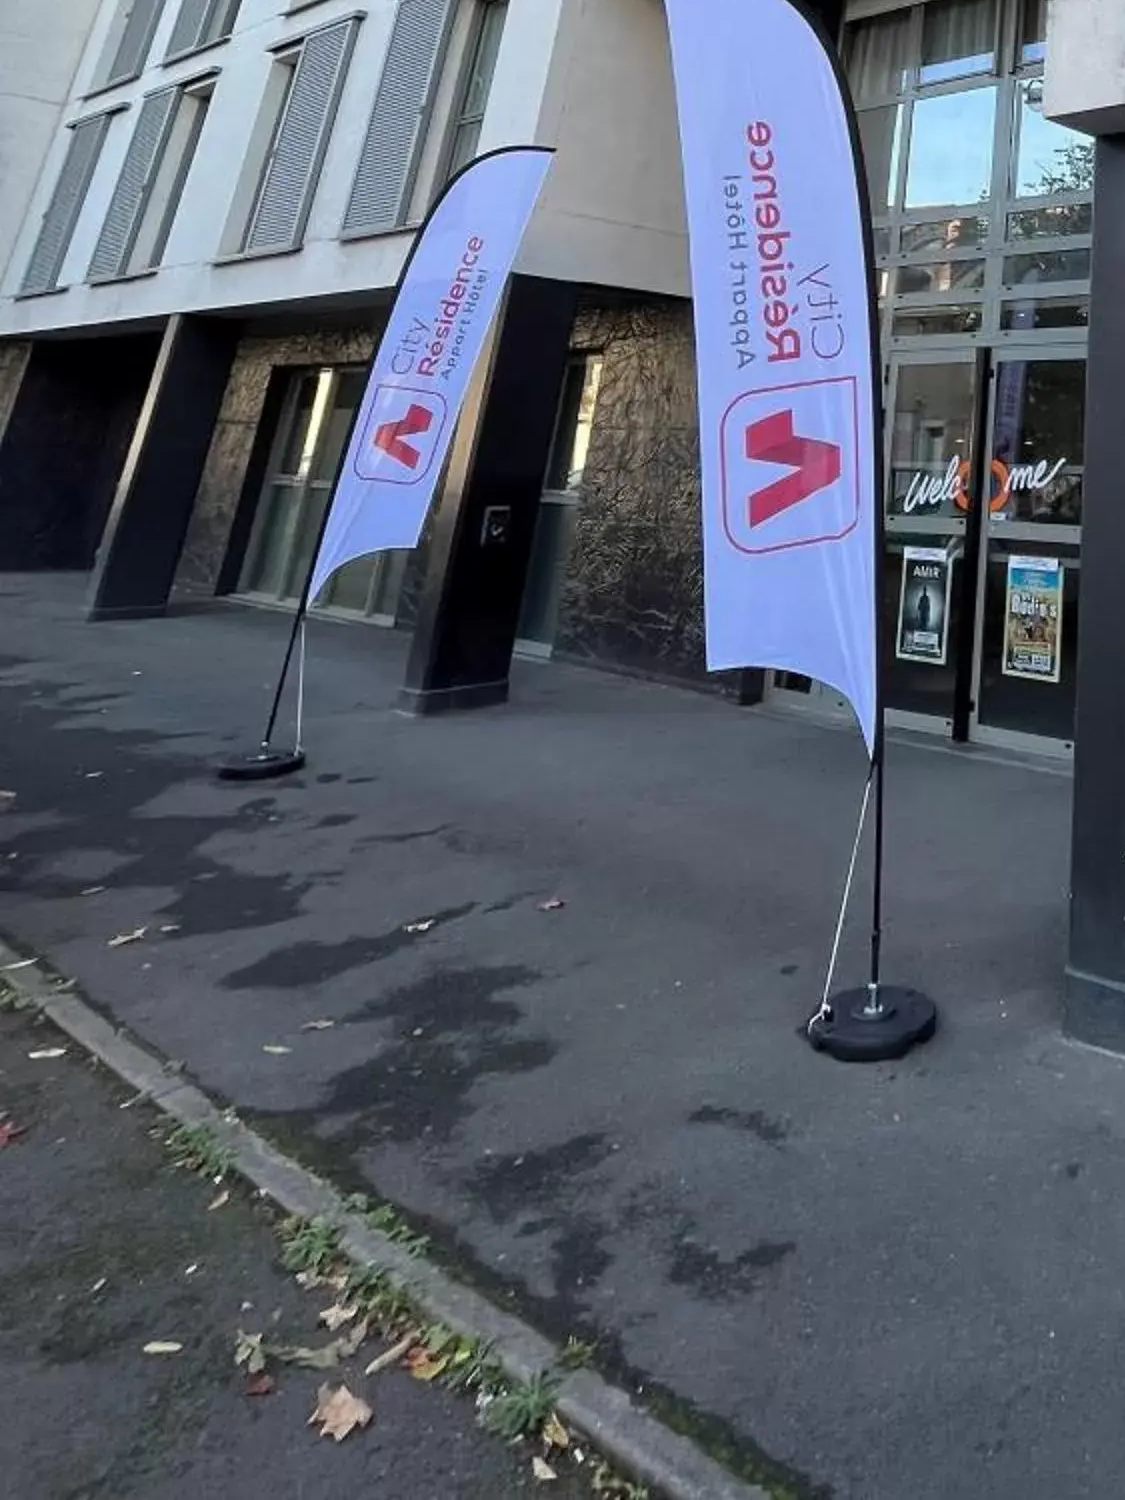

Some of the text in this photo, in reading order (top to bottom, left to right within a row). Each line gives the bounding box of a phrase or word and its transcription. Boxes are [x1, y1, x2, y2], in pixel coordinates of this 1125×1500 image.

[391, 317, 431, 375] City
[416, 236, 484, 377] Résidence
[440, 268, 488, 381] Appart Hôtel
